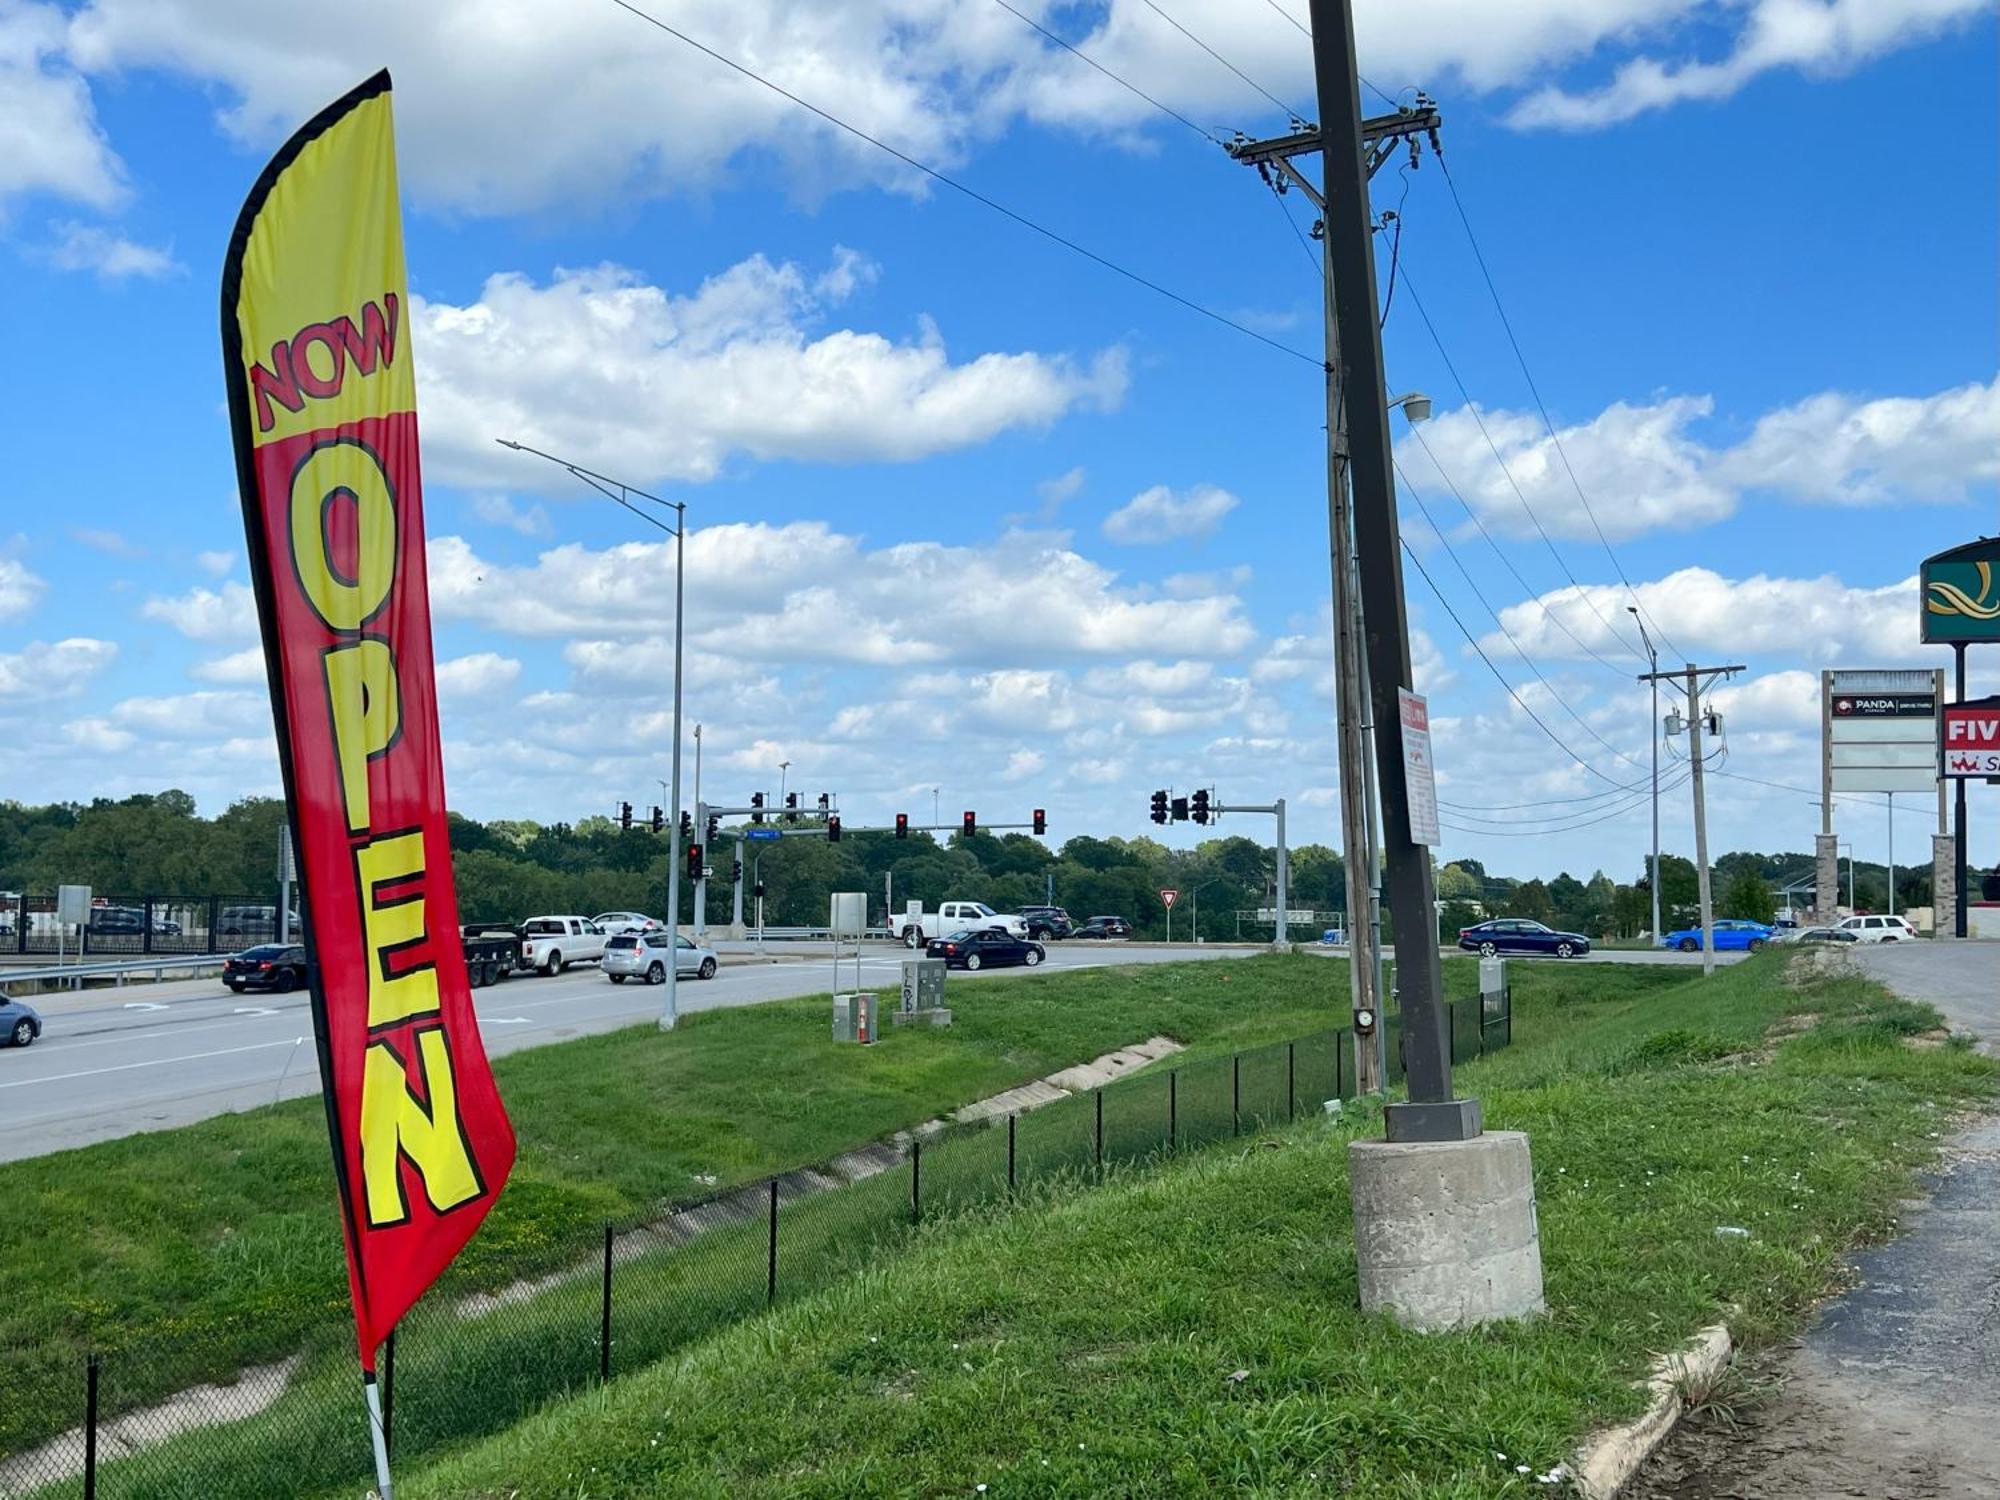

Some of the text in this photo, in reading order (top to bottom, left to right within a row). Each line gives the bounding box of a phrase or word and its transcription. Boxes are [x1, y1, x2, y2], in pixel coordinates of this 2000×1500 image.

[249, 291, 399, 432] NOW
[1855, 700, 1895, 709] PANDA
[1948, 719, 1999, 741] FIV
[286, 435, 487, 1231] OPEN
